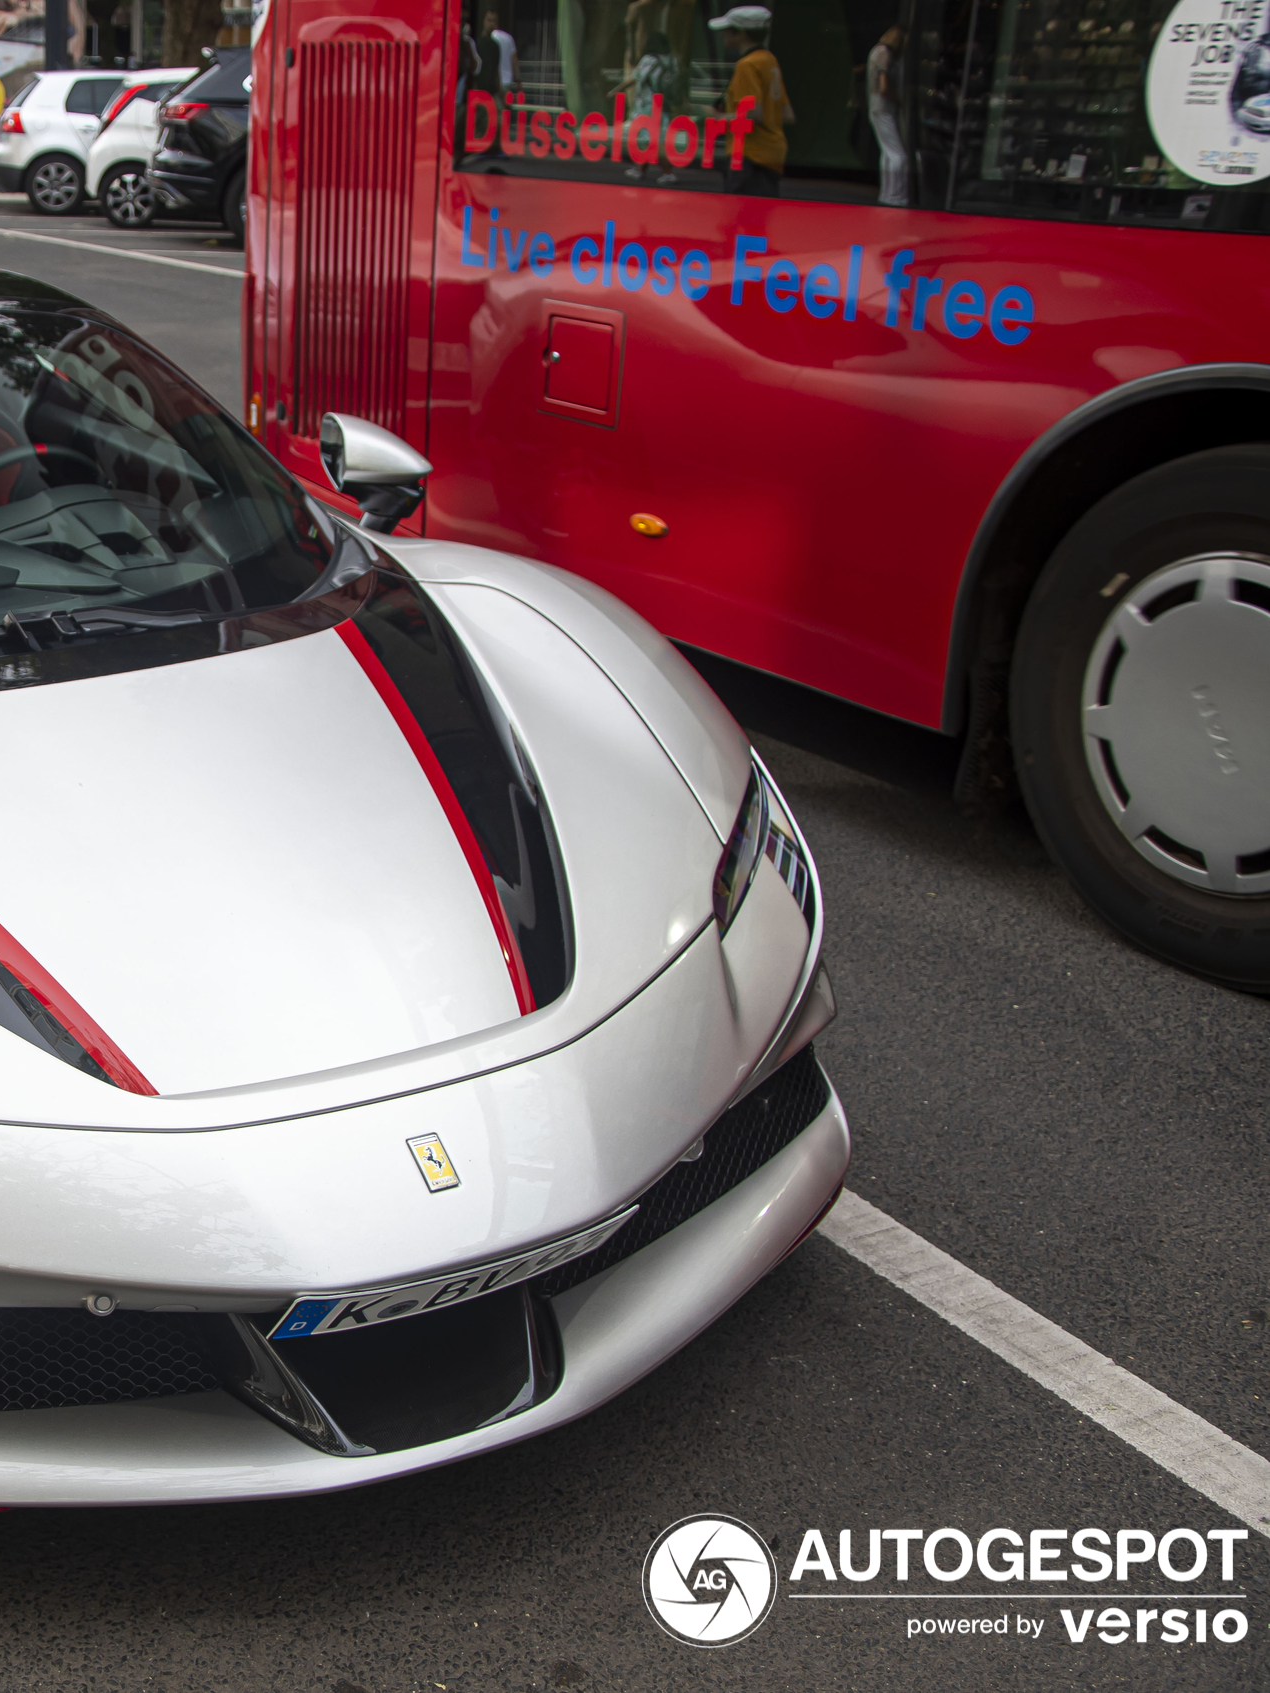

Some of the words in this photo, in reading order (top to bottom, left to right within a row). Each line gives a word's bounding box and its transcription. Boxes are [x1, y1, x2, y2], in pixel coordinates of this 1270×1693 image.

[1219, 0, 1264, 20] THE
[1169, 22, 1256, 43] SEVENS
[1190, 44, 1235, 67] JOB
[464, 88, 756, 170] Düsseldorf
[461, 204, 555, 278] Live
[570, 220, 712, 301] close
[730, 234, 863, 323] Feel
[883, 249, 1036, 346] free
[326, 1294, 395, 1329] K
[289, 1321, 308, 1332] D
